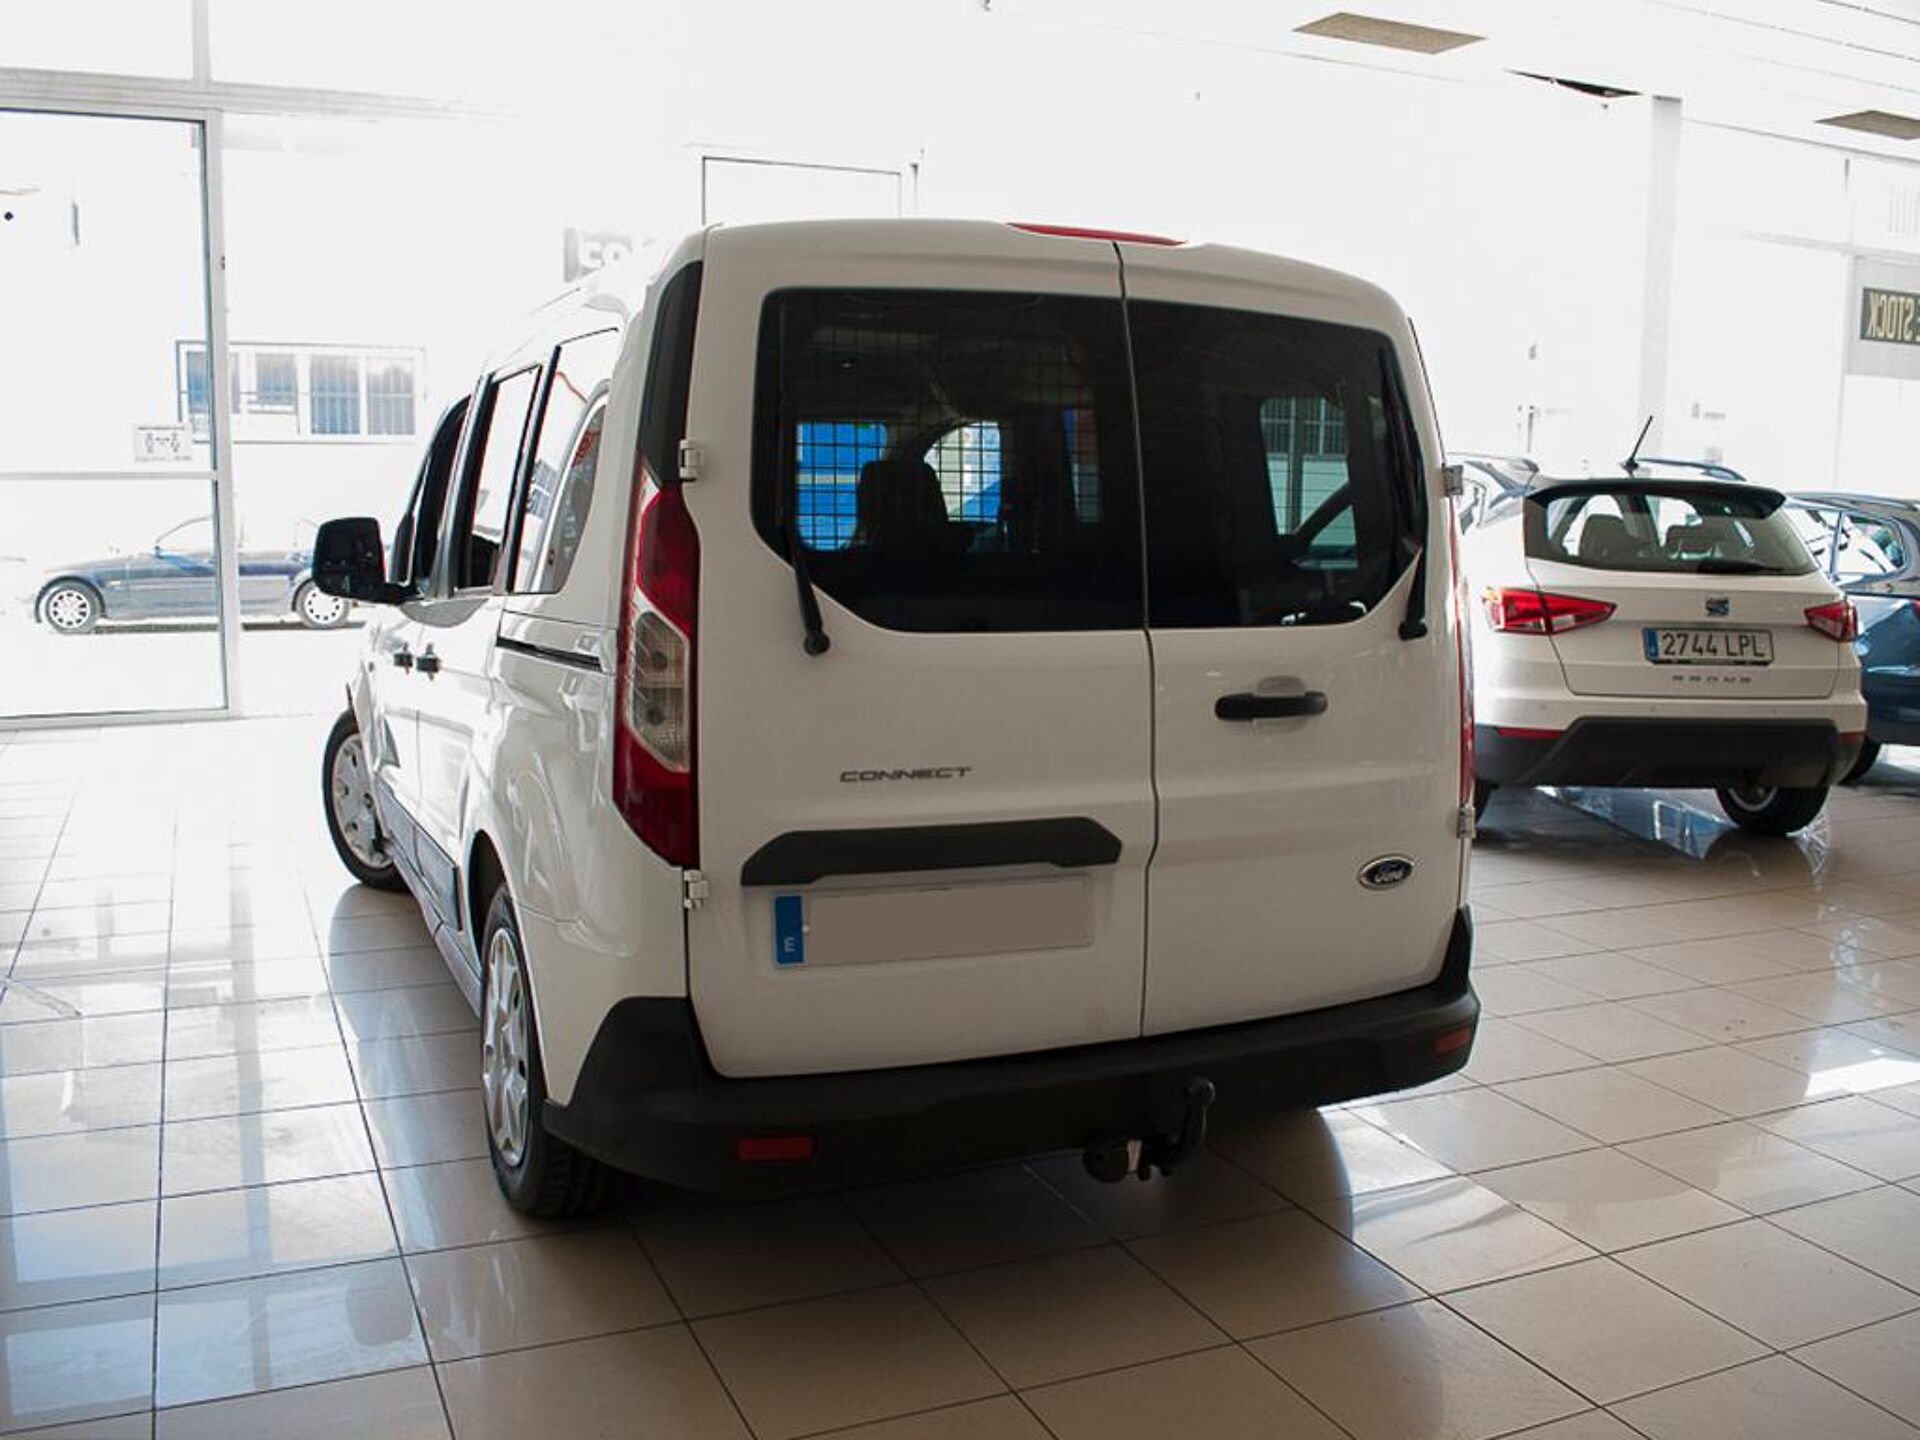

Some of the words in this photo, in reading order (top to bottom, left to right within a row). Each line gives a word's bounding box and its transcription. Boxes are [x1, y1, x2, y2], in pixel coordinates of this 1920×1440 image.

[1662, 632, 1719, 656] 2744
[1724, 634, 1766, 657] LPL
[840, 766, 973, 782] CONNECT
[783, 936, 796, 953] E
